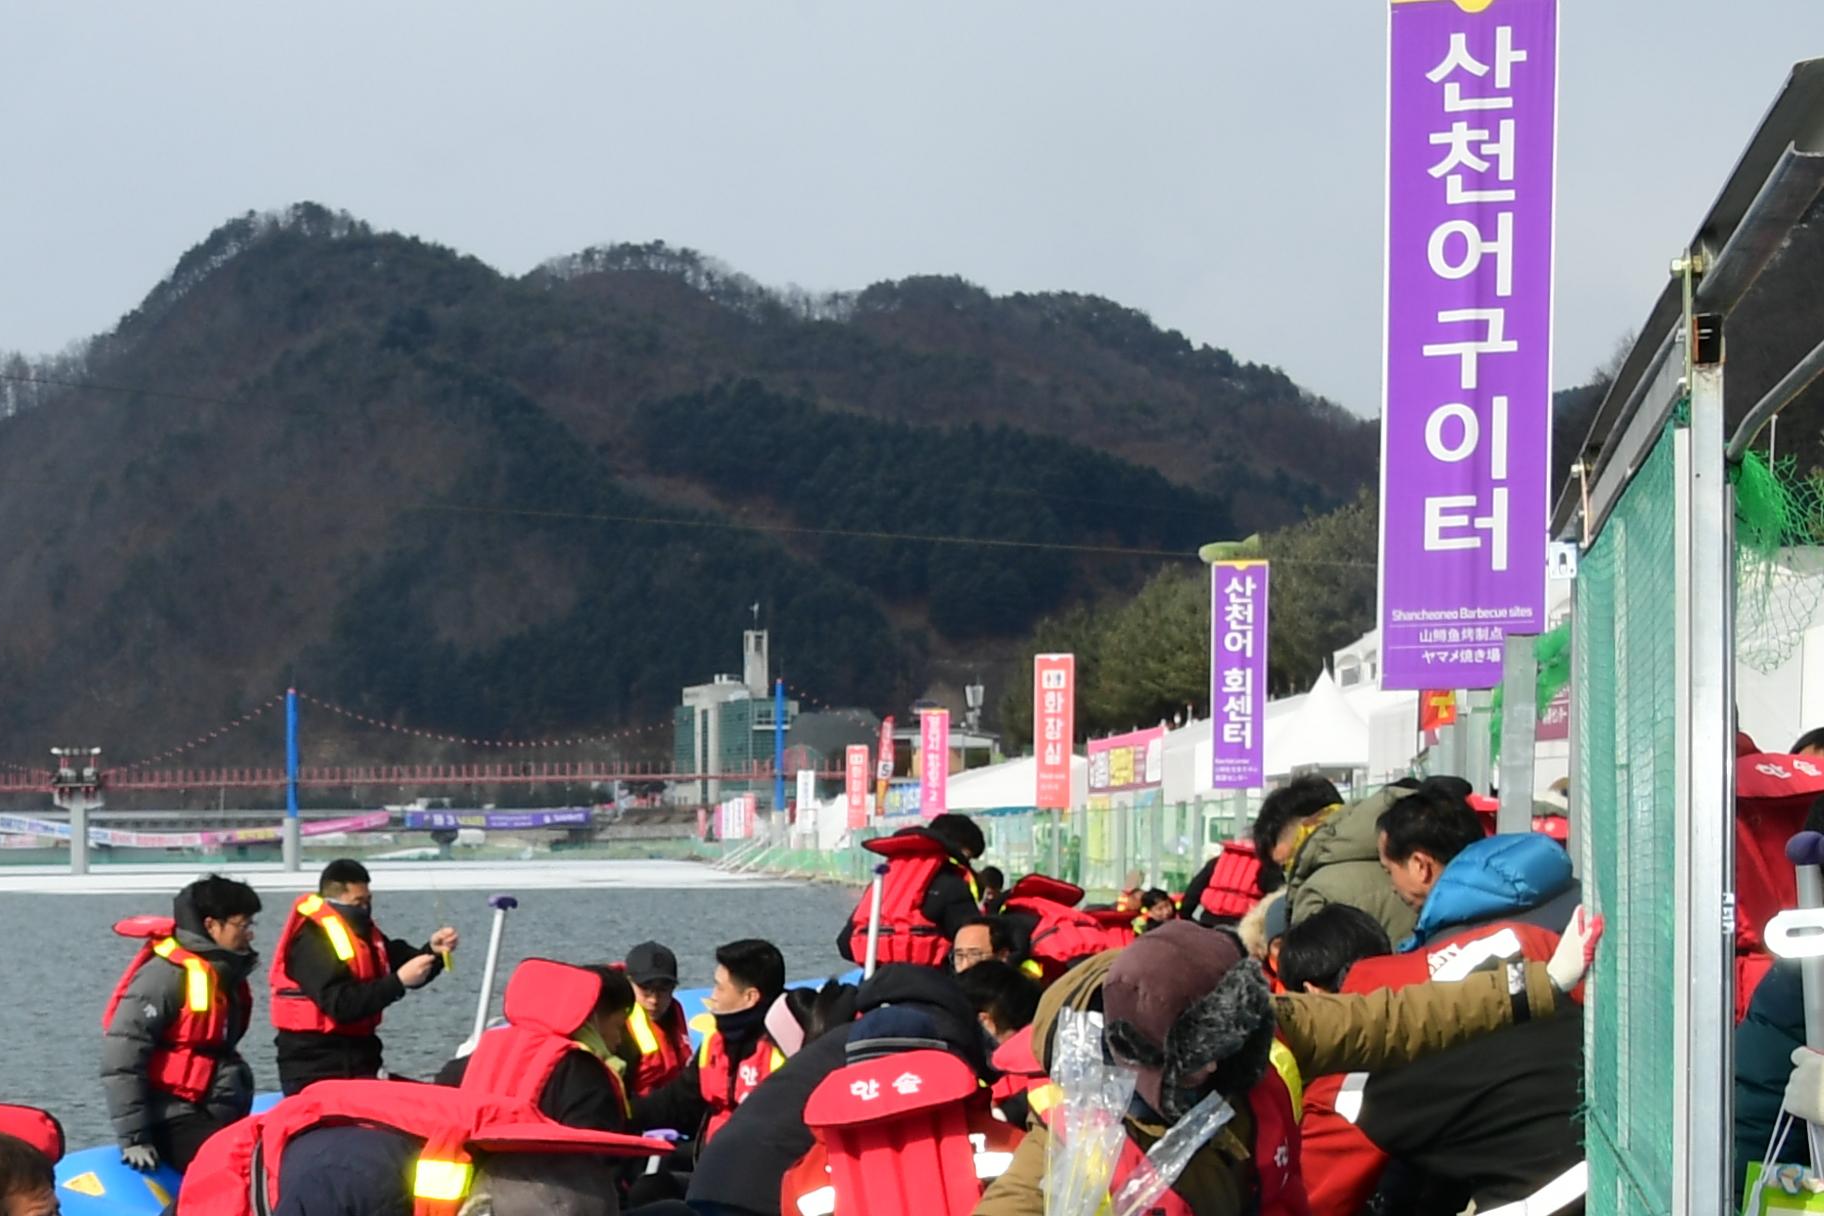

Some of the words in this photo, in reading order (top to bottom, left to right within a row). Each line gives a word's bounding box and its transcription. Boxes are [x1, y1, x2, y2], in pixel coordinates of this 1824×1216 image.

[1421, 26, 1527, 571] 산천어구이터
[1223, 575, 1256, 658] 산천어
[1460, 607, 1507, 619] Barbecue
[1509, 606, 1532, 618] sites
[1423, 649, 1501, 663] ヤマメ焼き場
[1044, 691, 1064, 765] 화장실
[1222, 667, 1253, 750] 회센터
